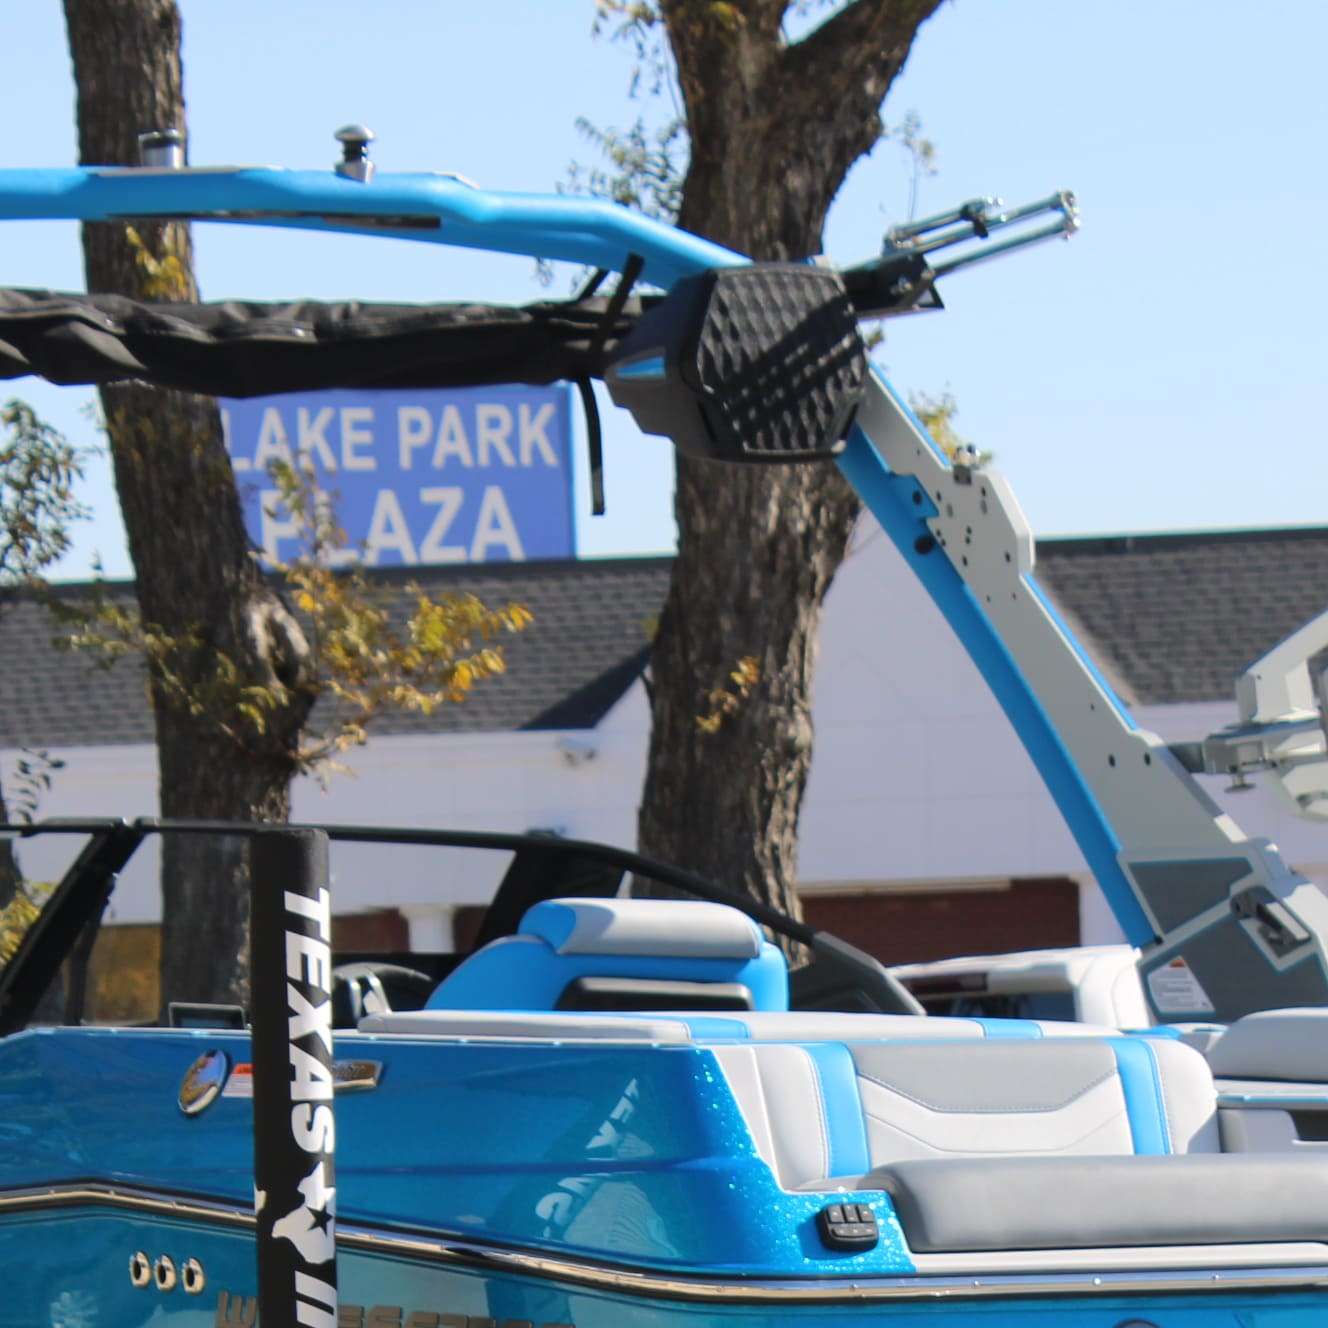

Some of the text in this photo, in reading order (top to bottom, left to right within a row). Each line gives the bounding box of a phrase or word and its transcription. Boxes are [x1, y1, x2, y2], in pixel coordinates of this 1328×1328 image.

[225, 403, 559, 471] LAKE PARK
[260, 485, 526, 571] PLAZA
[283, 886, 336, 1155] TEXAS
